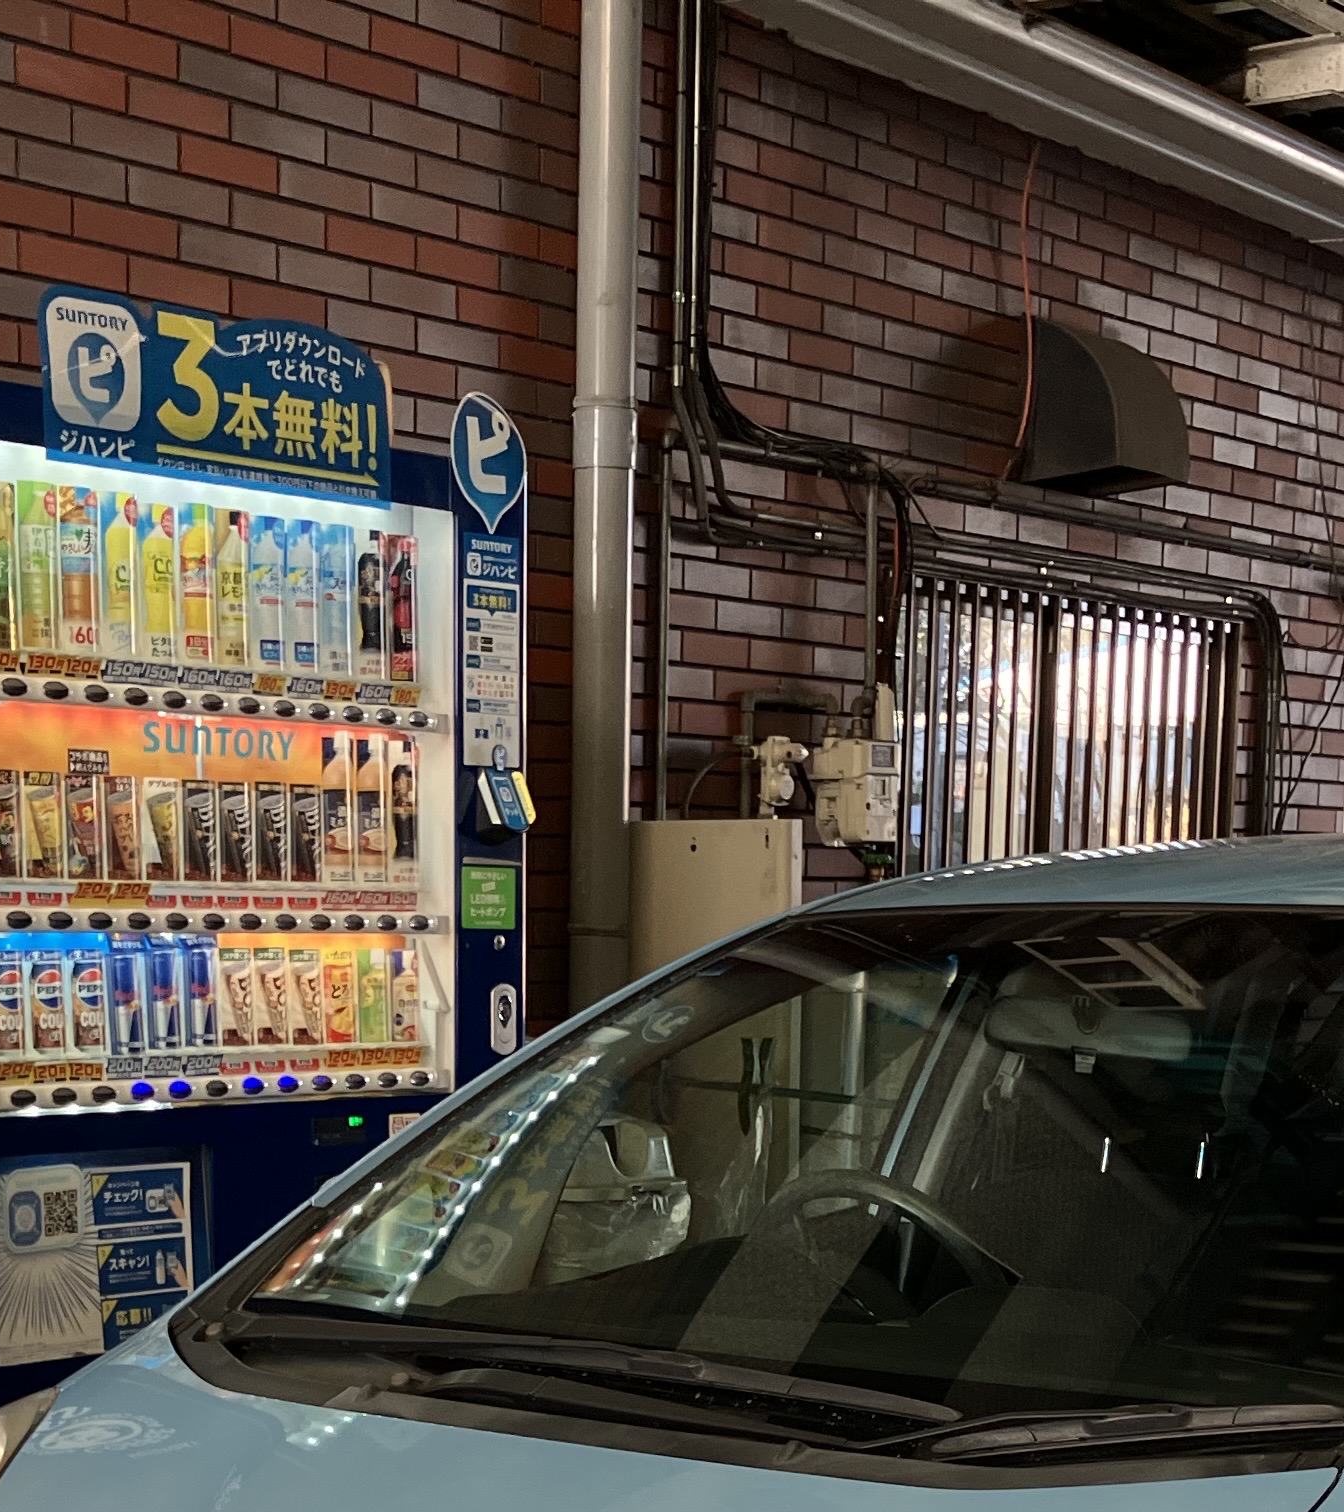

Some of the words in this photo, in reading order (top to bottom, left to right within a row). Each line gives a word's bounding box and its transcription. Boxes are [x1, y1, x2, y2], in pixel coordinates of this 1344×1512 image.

[56, 306, 129, 332] SUNTORY
[236, 328, 367, 379] アプリダウンロード
[267, 359, 344, 394] でどれでも
[59, 429, 136, 463] ジハンピ
[471, 539, 513, 554] SUNTORY
[483, 562, 518, 580] ジハンピ
[143, 721, 295, 761] SUNTORY
[103, 1188, 144, 1204] チェック!
[109, 1255, 150, 1271] スキャン!
